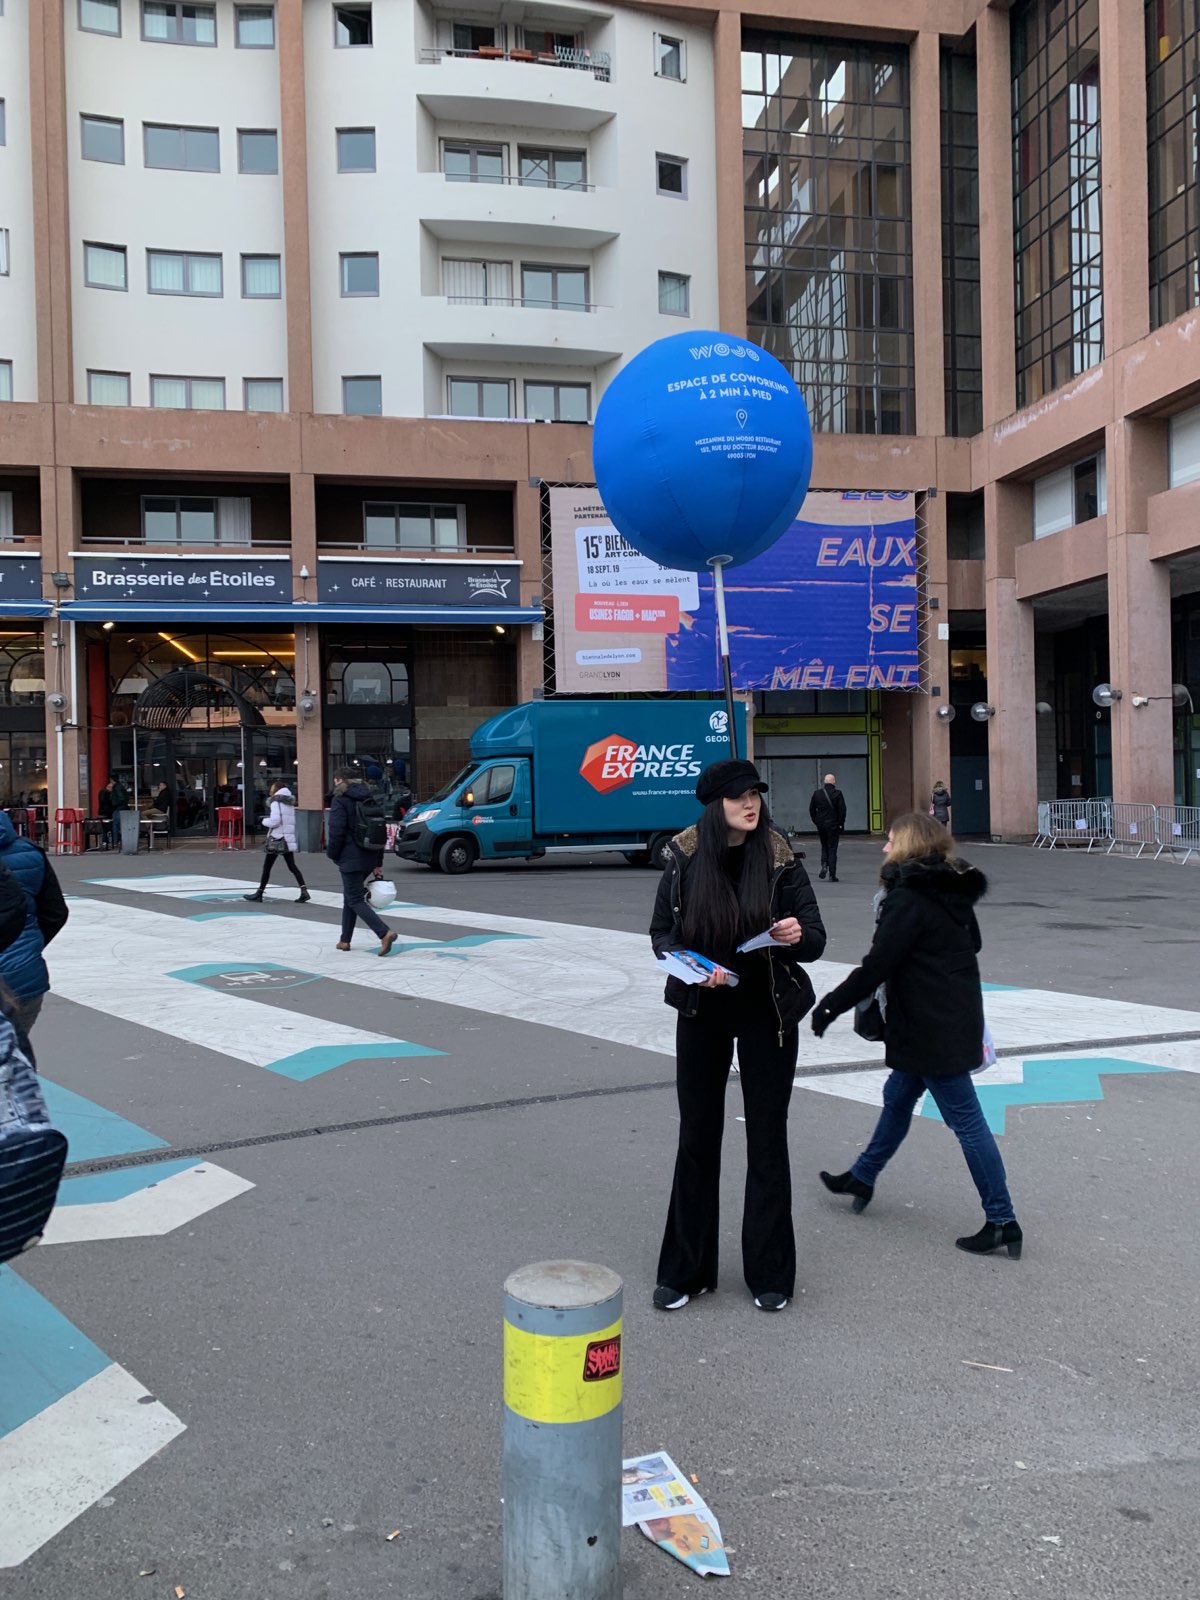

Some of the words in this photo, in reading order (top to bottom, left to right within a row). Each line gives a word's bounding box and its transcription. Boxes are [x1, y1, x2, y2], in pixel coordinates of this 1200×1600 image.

[667, 377, 708, 393] ESPACE
[711, 373, 727, 384] DE
[729, 373, 790, 394] COWORKING
[700, 388, 708, 401] À
[709, 390, 717, 400] 2
[719, 388, 741, 398] MIN
[743, 385, 751, 397] À
[752, 389, 772, 401] PIED
[695, 436, 725, 446] MEZZANINE
[755, 436, 782, 446] RESTAURANT
[732, 443, 757, 451] DOCTEUR
[816, 537, 917, 567] EAUX
[587, 565, 595, 574] 18
[594, 565, 612, 574] SEPT.
[612, 564, 620, 573] 19
[92, 570, 184, 586] Brasserie
[187, 572, 207, 585] des
[209, 570, 276, 587] Étoiles
[351, 576, 376, 588] CAFÉ
[386, 579, 447, 589] RESTAURANT
[631, 578, 649, 586] eaux
[867, 603, 915, 633] SE
[605, 744, 695, 762] FRANCE
[601, 760, 702, 779] EXPRESS
